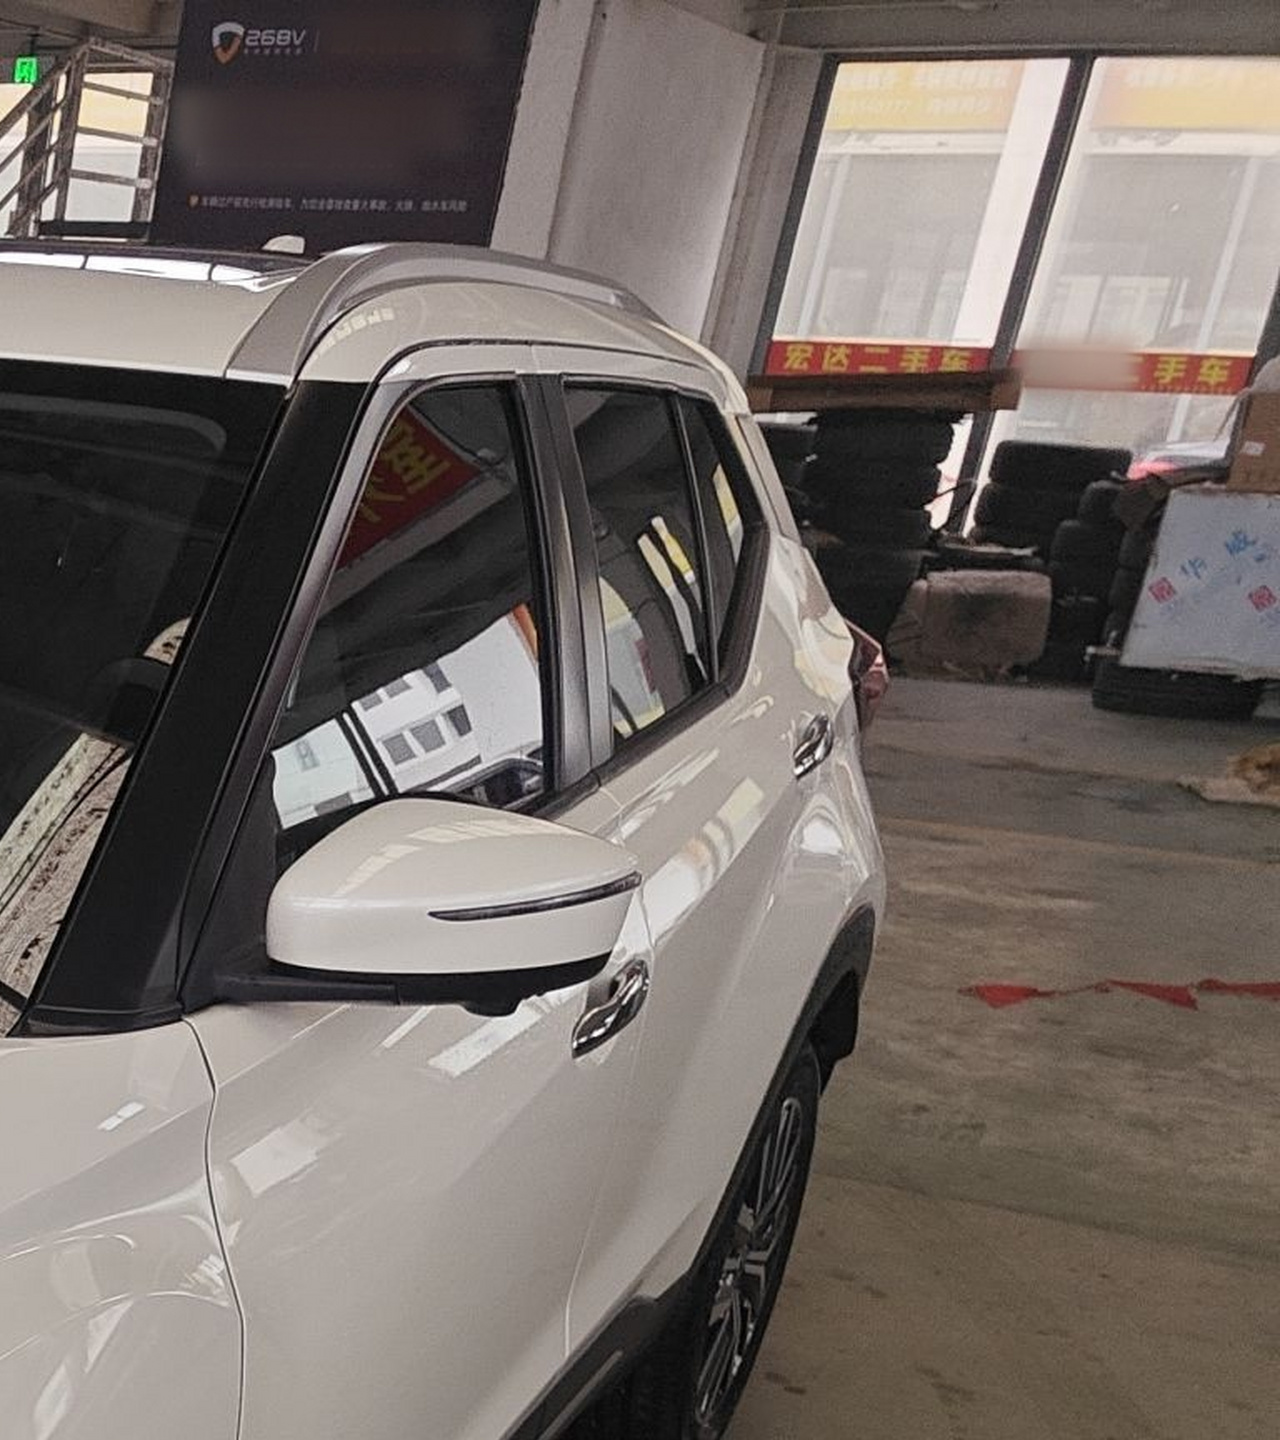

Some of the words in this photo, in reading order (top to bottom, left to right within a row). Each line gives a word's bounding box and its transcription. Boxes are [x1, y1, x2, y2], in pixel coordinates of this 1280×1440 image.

[245, 29, 306, 46] 268V
[784, 343, 971, 374] 宏达二手车
[1132, 355, 1232, 385] 手车
